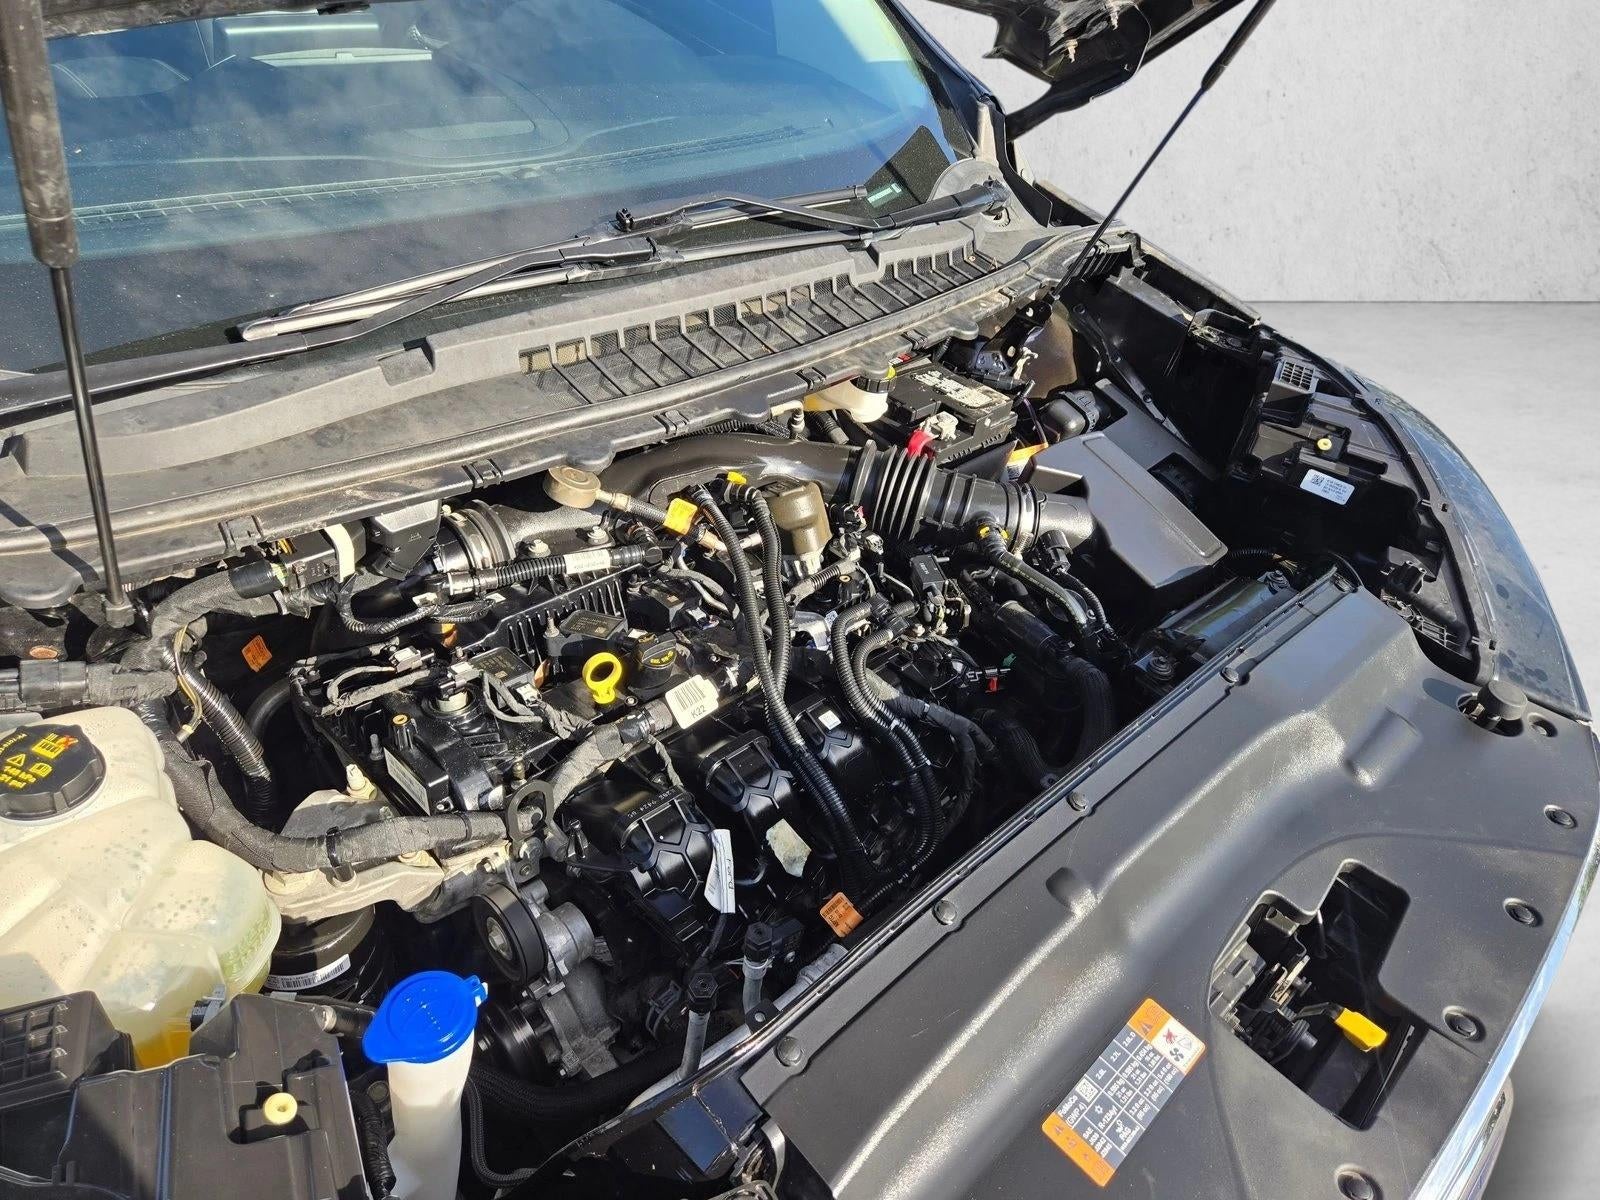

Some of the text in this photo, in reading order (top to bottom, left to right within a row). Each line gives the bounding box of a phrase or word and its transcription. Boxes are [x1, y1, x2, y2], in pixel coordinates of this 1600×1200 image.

[690, 704, 706, 719] K22
[1058, 1094, 1078, 1117] FoMoCo
[1065, 1101, 1087, 1127] (GWP 4)
[1097, 1106, 1119, 1129] R-1234yf
[1082, 1126, 1093, 1138] SAE
[1118, 1126, 1131, 1140] PAG
